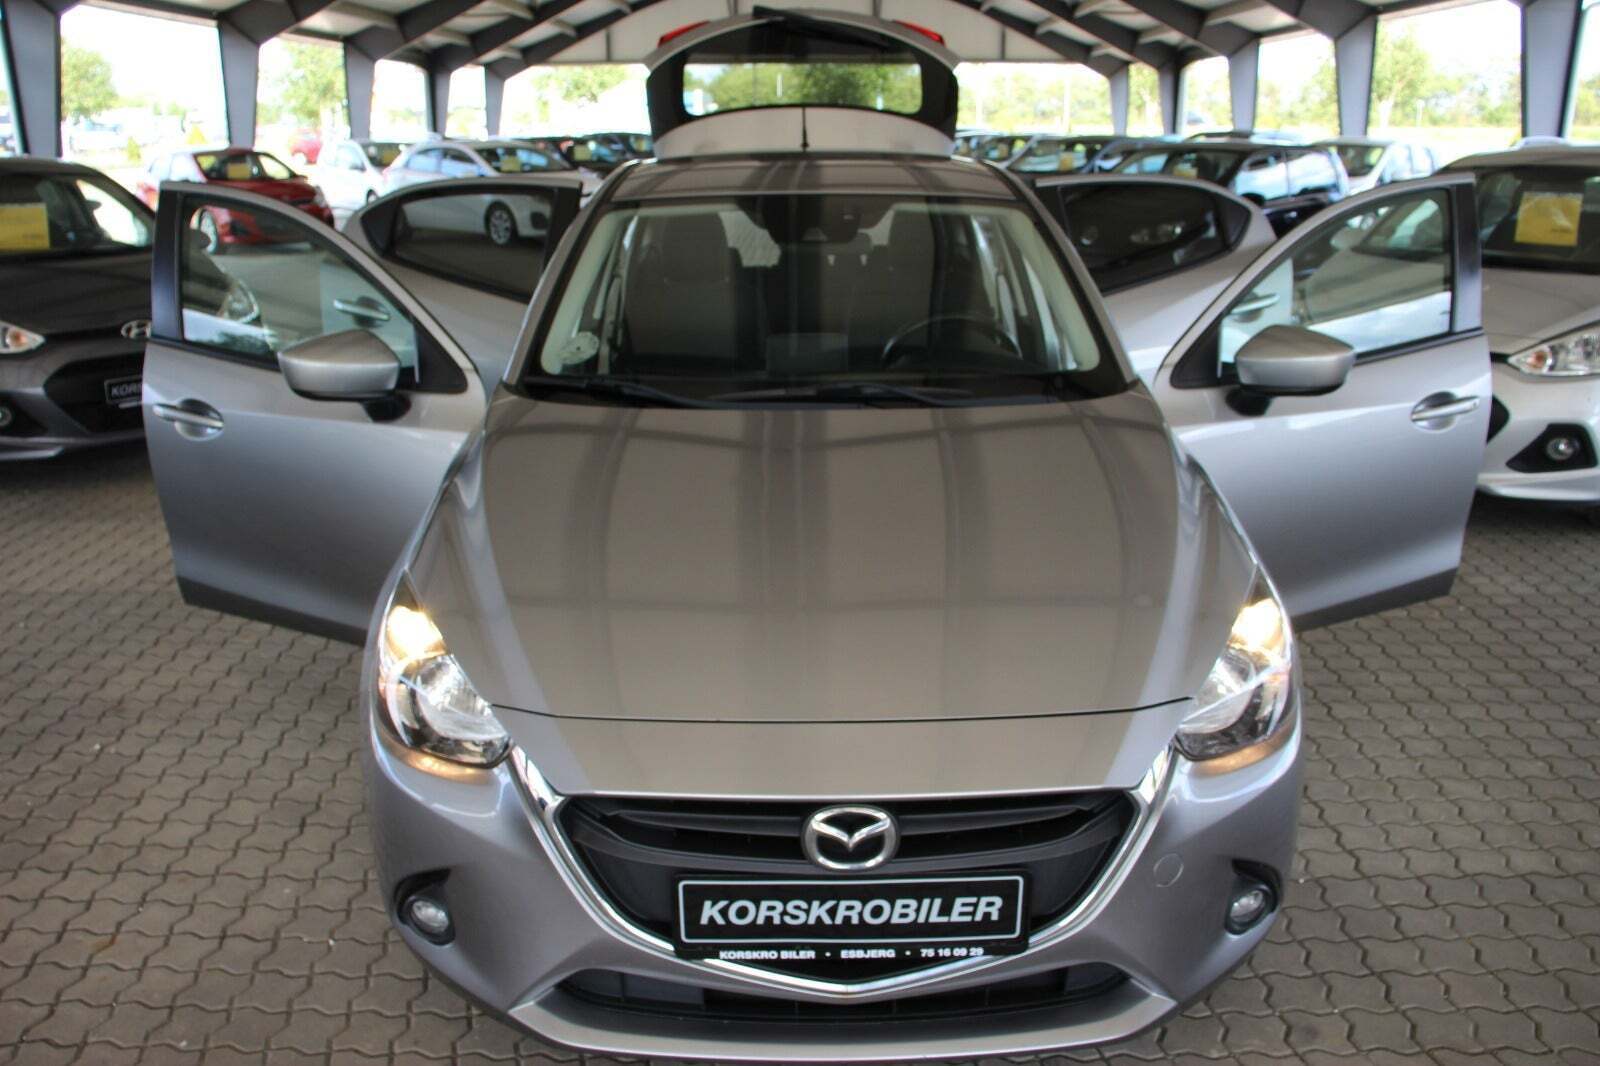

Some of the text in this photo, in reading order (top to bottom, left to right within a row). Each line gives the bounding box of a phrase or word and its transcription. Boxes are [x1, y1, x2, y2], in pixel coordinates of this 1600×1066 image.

[700, 896, 1002, 925] KORSKROBILER
[719, 950, 778, 960] KORSKRO
[780, 950, 816, 960] BILER
[840, 949, 896, 959] ESBJERG
[920, 947, 935, 957] 75
[937, 947, 951, 957] 16
[969, 946, 984, 956] 29
